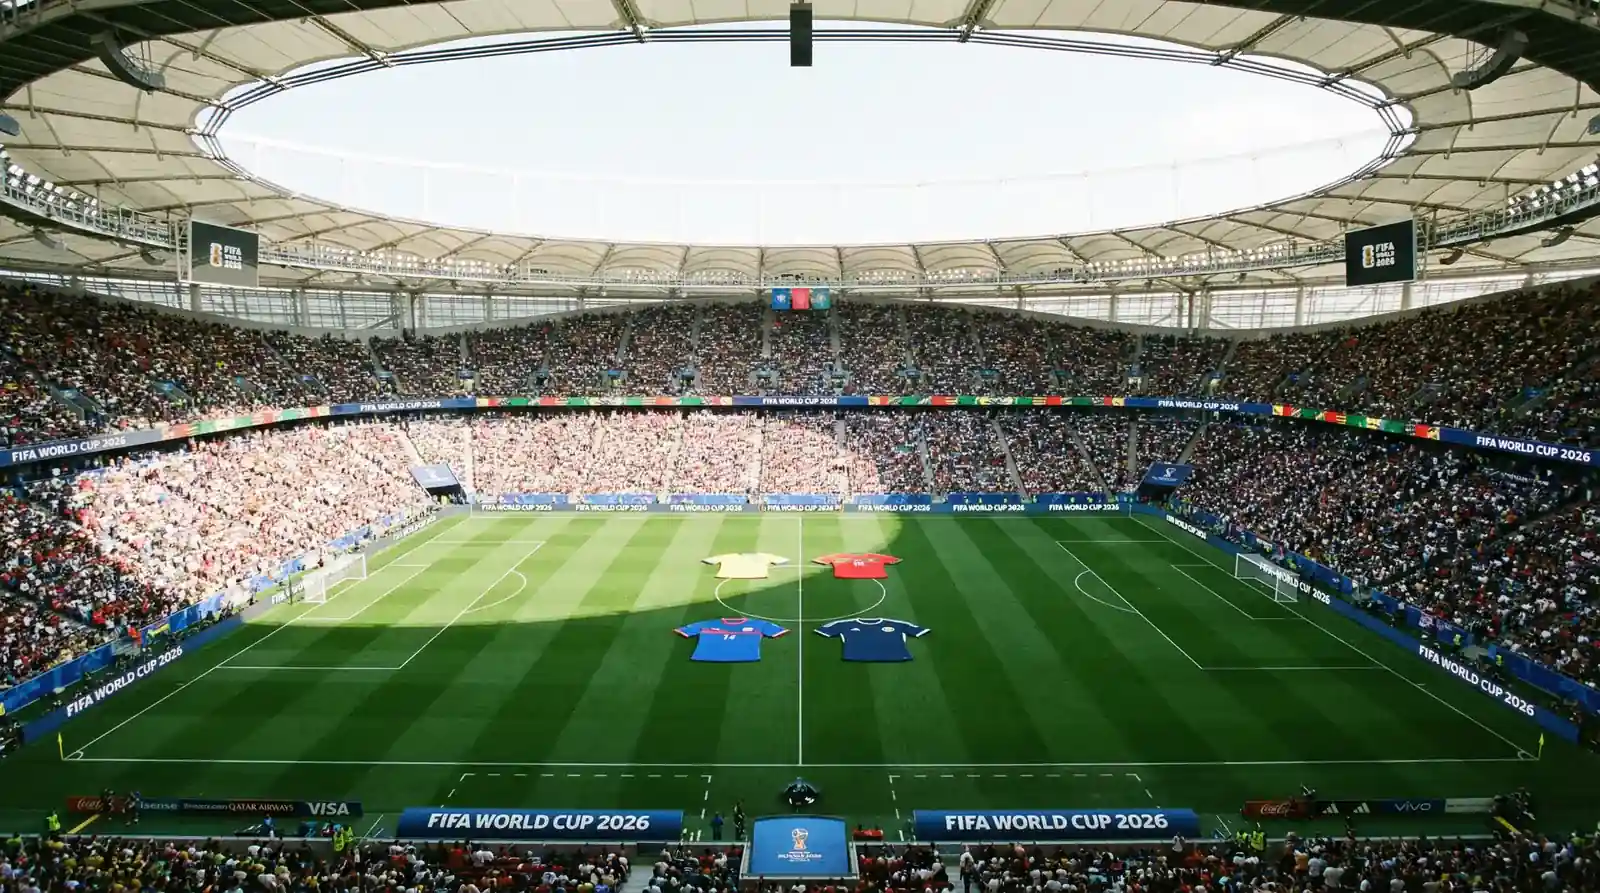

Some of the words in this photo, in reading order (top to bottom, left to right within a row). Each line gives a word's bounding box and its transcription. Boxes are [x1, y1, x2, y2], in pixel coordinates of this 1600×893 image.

[1376, 242, 1395, 252] FIFA
[360, 404, 377, 412] FIFA
[1158, 400, 1174, 408] FIFA
[1203, 402, 1219, 410] CUP
[12, 451, 36, 462] FIFA
[38, 443, 78, 458] WORLD
[80, 440, 100, 452] CUP
[102, 436, 126, 447] 2026
[1476, 436, 1496, 448] FIFA
[1498, 438, 1534, 454] WORLD
[1536, 444, 1558, 457] CUP
[1560, 448, 1591, 462] 2026
[712, 504, 724, 512] CUP
[858, 504, 874, 512] FIFA
[899, 504, 912, 512] CUP
[953, 504, 968, 512] FIFA
[994, 504, 1008, 512] CUP
[1049, 504, 1063, 512] FIFA
[1089, 504, 1102, 512] CUP
[1312, 587, 1331, 605] 2026
[66, 696, 94, 718] FIFA
[94, 672, 135, 701] WORLD
[136, 659, 157, 678] CUP
[158, 646, 183, 666] 2026
[1418, 645, 1440, 665] FIFA
[1441, 656, 1479, 686] WORLD
[1480, 679, 1503, 698] CUP
[1504, 691, 1535, 717] 2026
[228, 804, 257, 812] QATAR
[258, 804, 294, 812] AIRWAYS
[307, 802, 350, 816] VISA
[1394, 800, 1432, 812] vivo
[428, 813, 471, 829] FIFA
[475, 814, 549, 830] WORLD
[552, 814, 594, 830] CUP
[596, 815, 650, 831] 2026
[945, 815, 988, 831] FIFA
[992, 814, 1068, 831] WORLD
[1071, 814, 1112, 830] CUP
[1115, 814, 1169, 830] 2026
